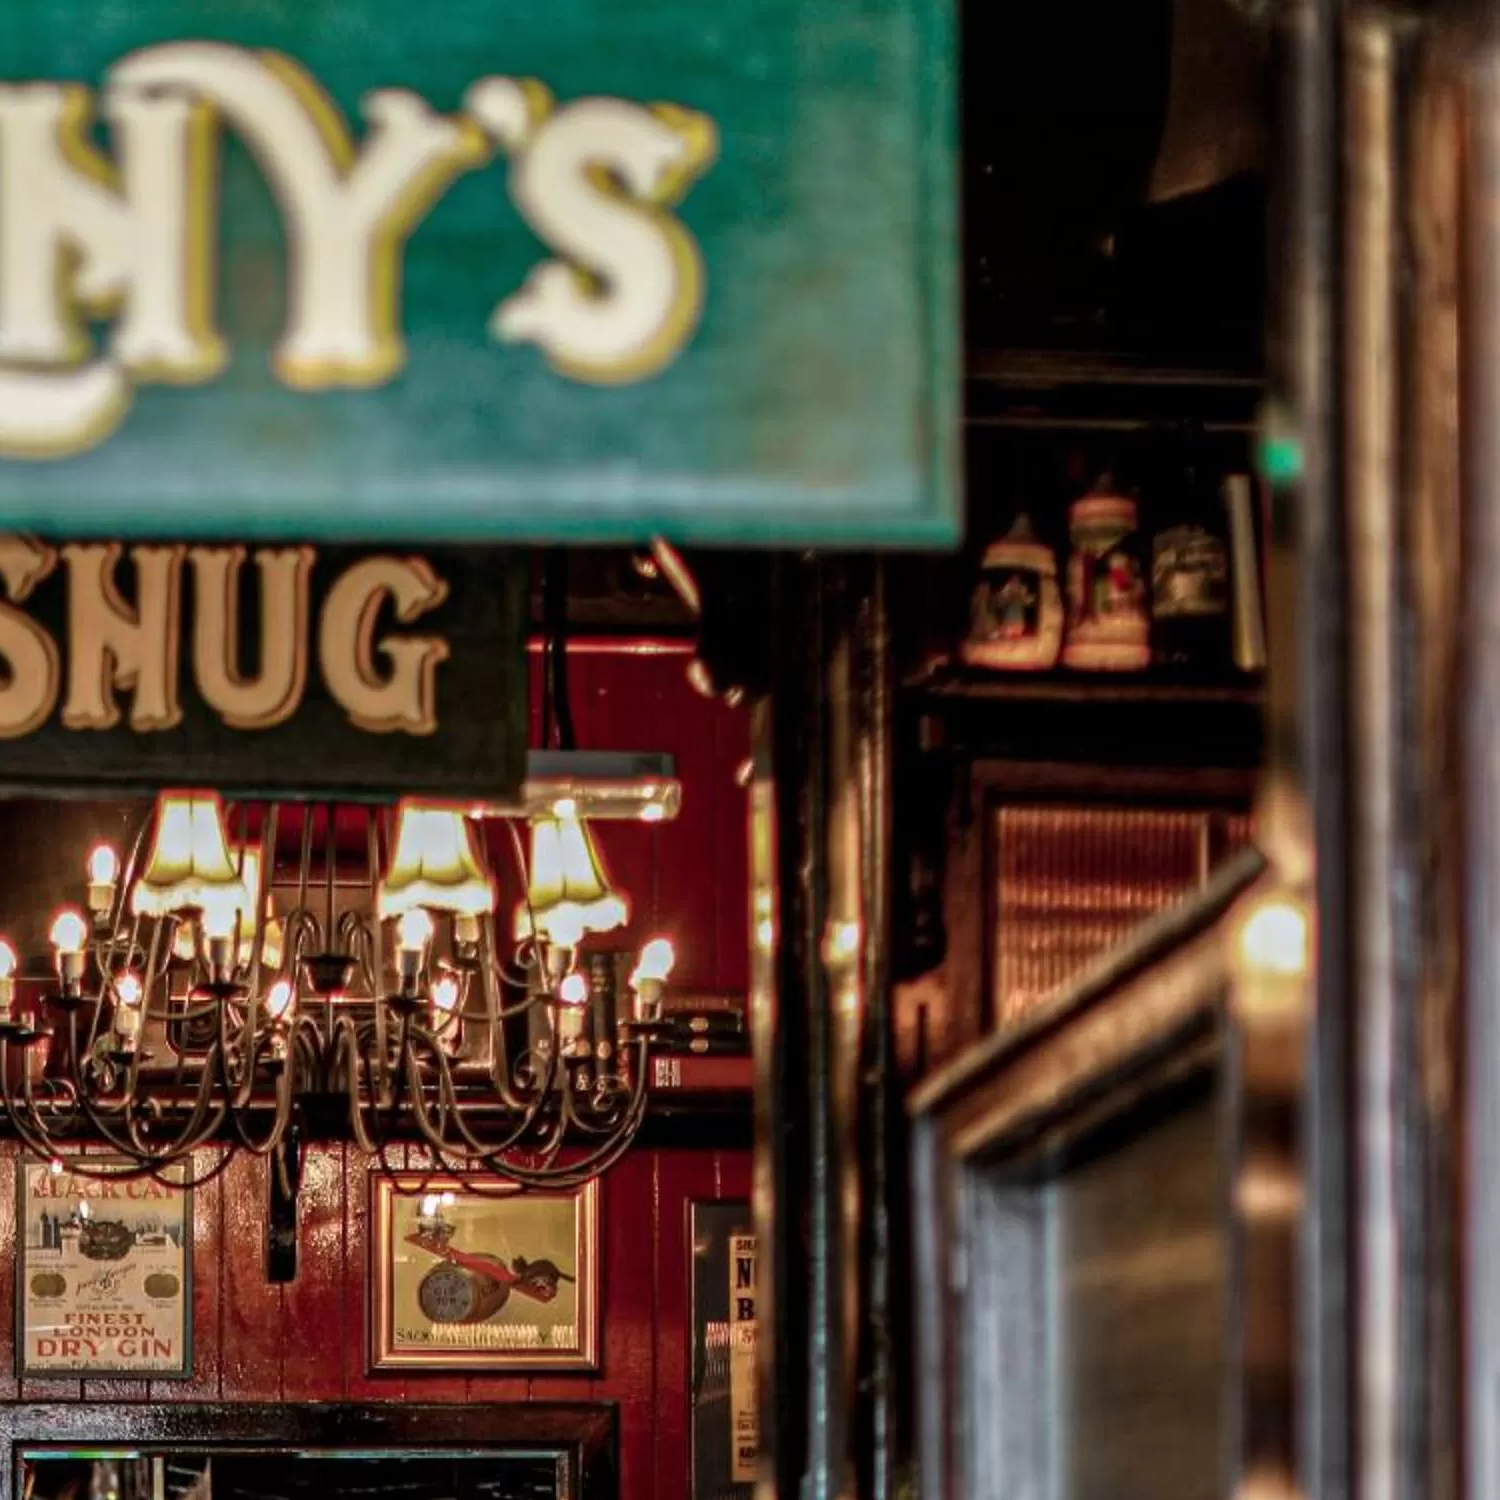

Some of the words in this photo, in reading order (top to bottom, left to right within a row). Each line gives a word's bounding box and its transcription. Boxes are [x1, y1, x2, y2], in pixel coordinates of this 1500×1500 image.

[64, 1312, 147, 1325] FINEST
[53, 1325, 156, 1338] LONDON
[36, 1338, 103, 1358] DRY
[115, 1338, 173, 1358] GIN
